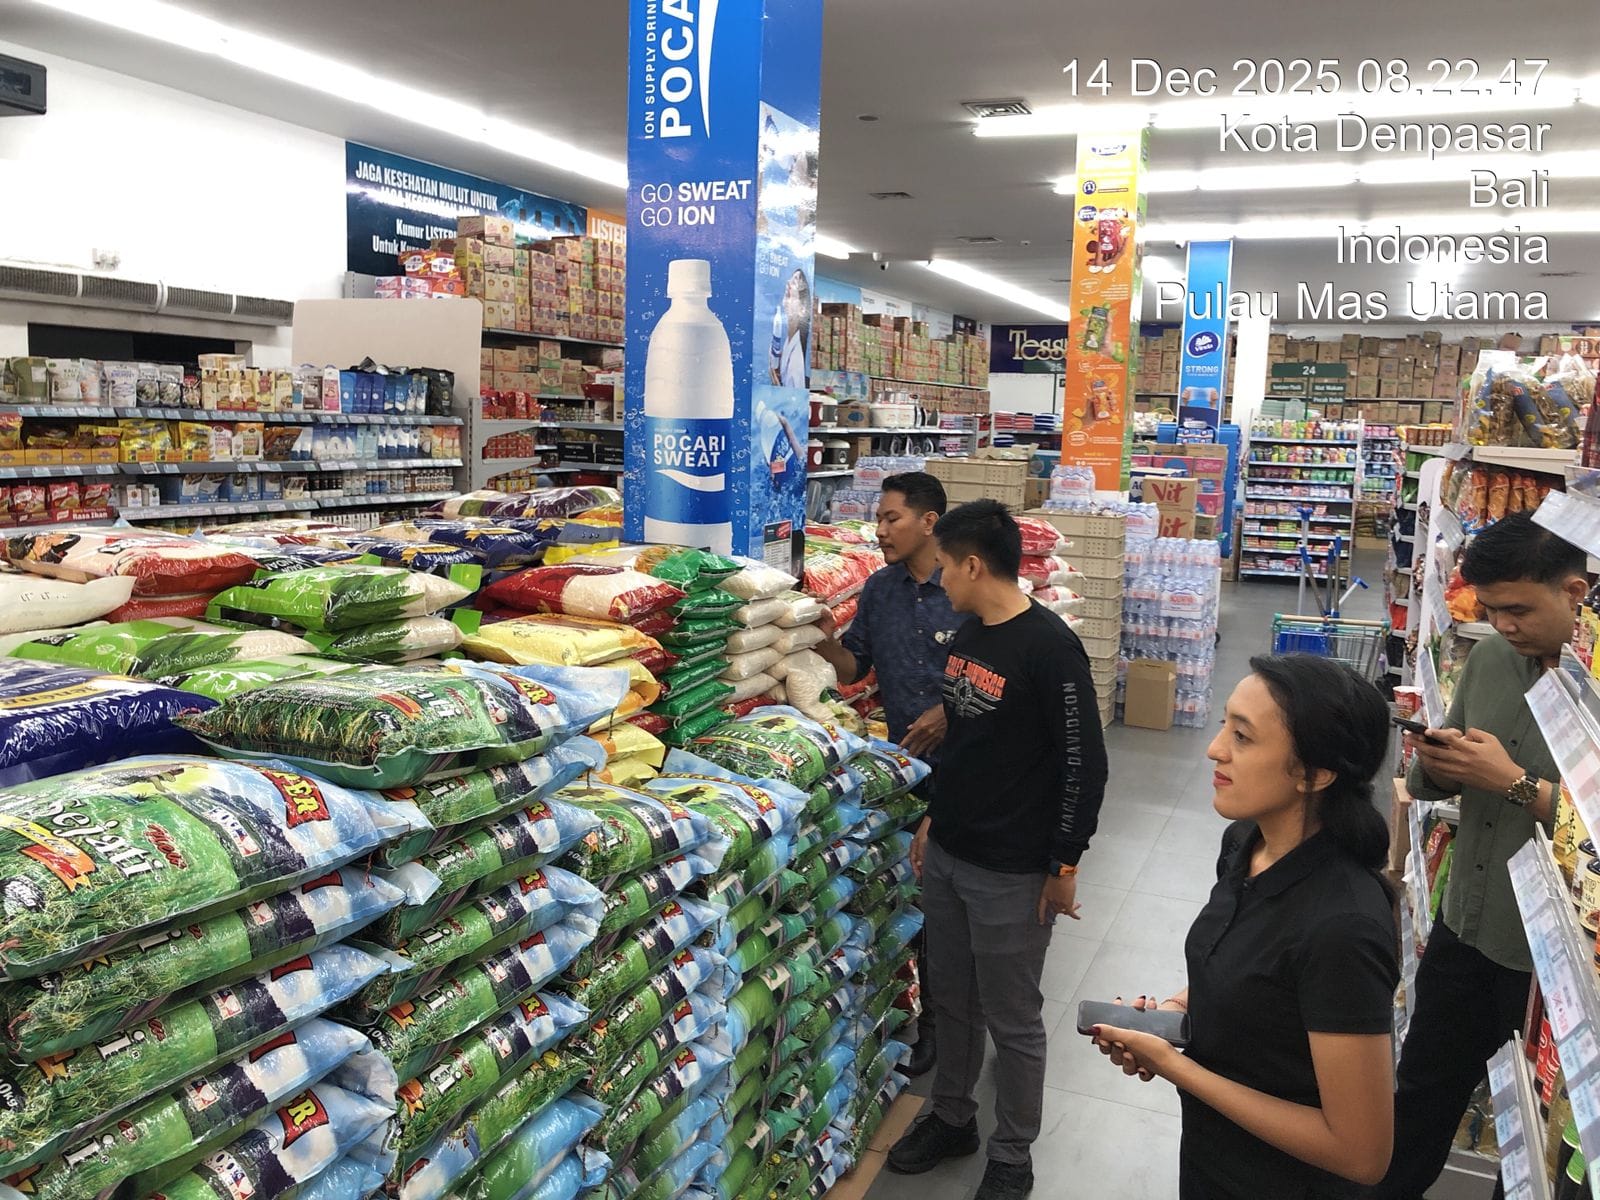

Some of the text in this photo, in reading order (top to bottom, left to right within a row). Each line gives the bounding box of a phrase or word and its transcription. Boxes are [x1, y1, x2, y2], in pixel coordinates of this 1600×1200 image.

[645, 0, 657, 139] ION SUPPLY DRIN
[356, 161, 498, 212] JAGA KESEHATAN MULUT UNTUK
[640, 179, 752, 204] GO SWEAT
[640, 204, 716, 227] GO ION
[396, 218, 425, 240] Kumur
[372, 235, 399, 256] Untuk
[1008, 328, 1067, 361] Tess
[1050, 363, 1063, 372] 25
[1185, 365, 1219, 374] STRONG
[1302, 365, 1316, 376] 24
[653, 433, 726, 452] POCARI
[653, 449, 721, 468] SWEAT
[1151, 480, 1188, 503] Vit
[1159, 513, 1188, 538] it
[1060, 681, 1082, 833] HARLEY-DAVIDSON
